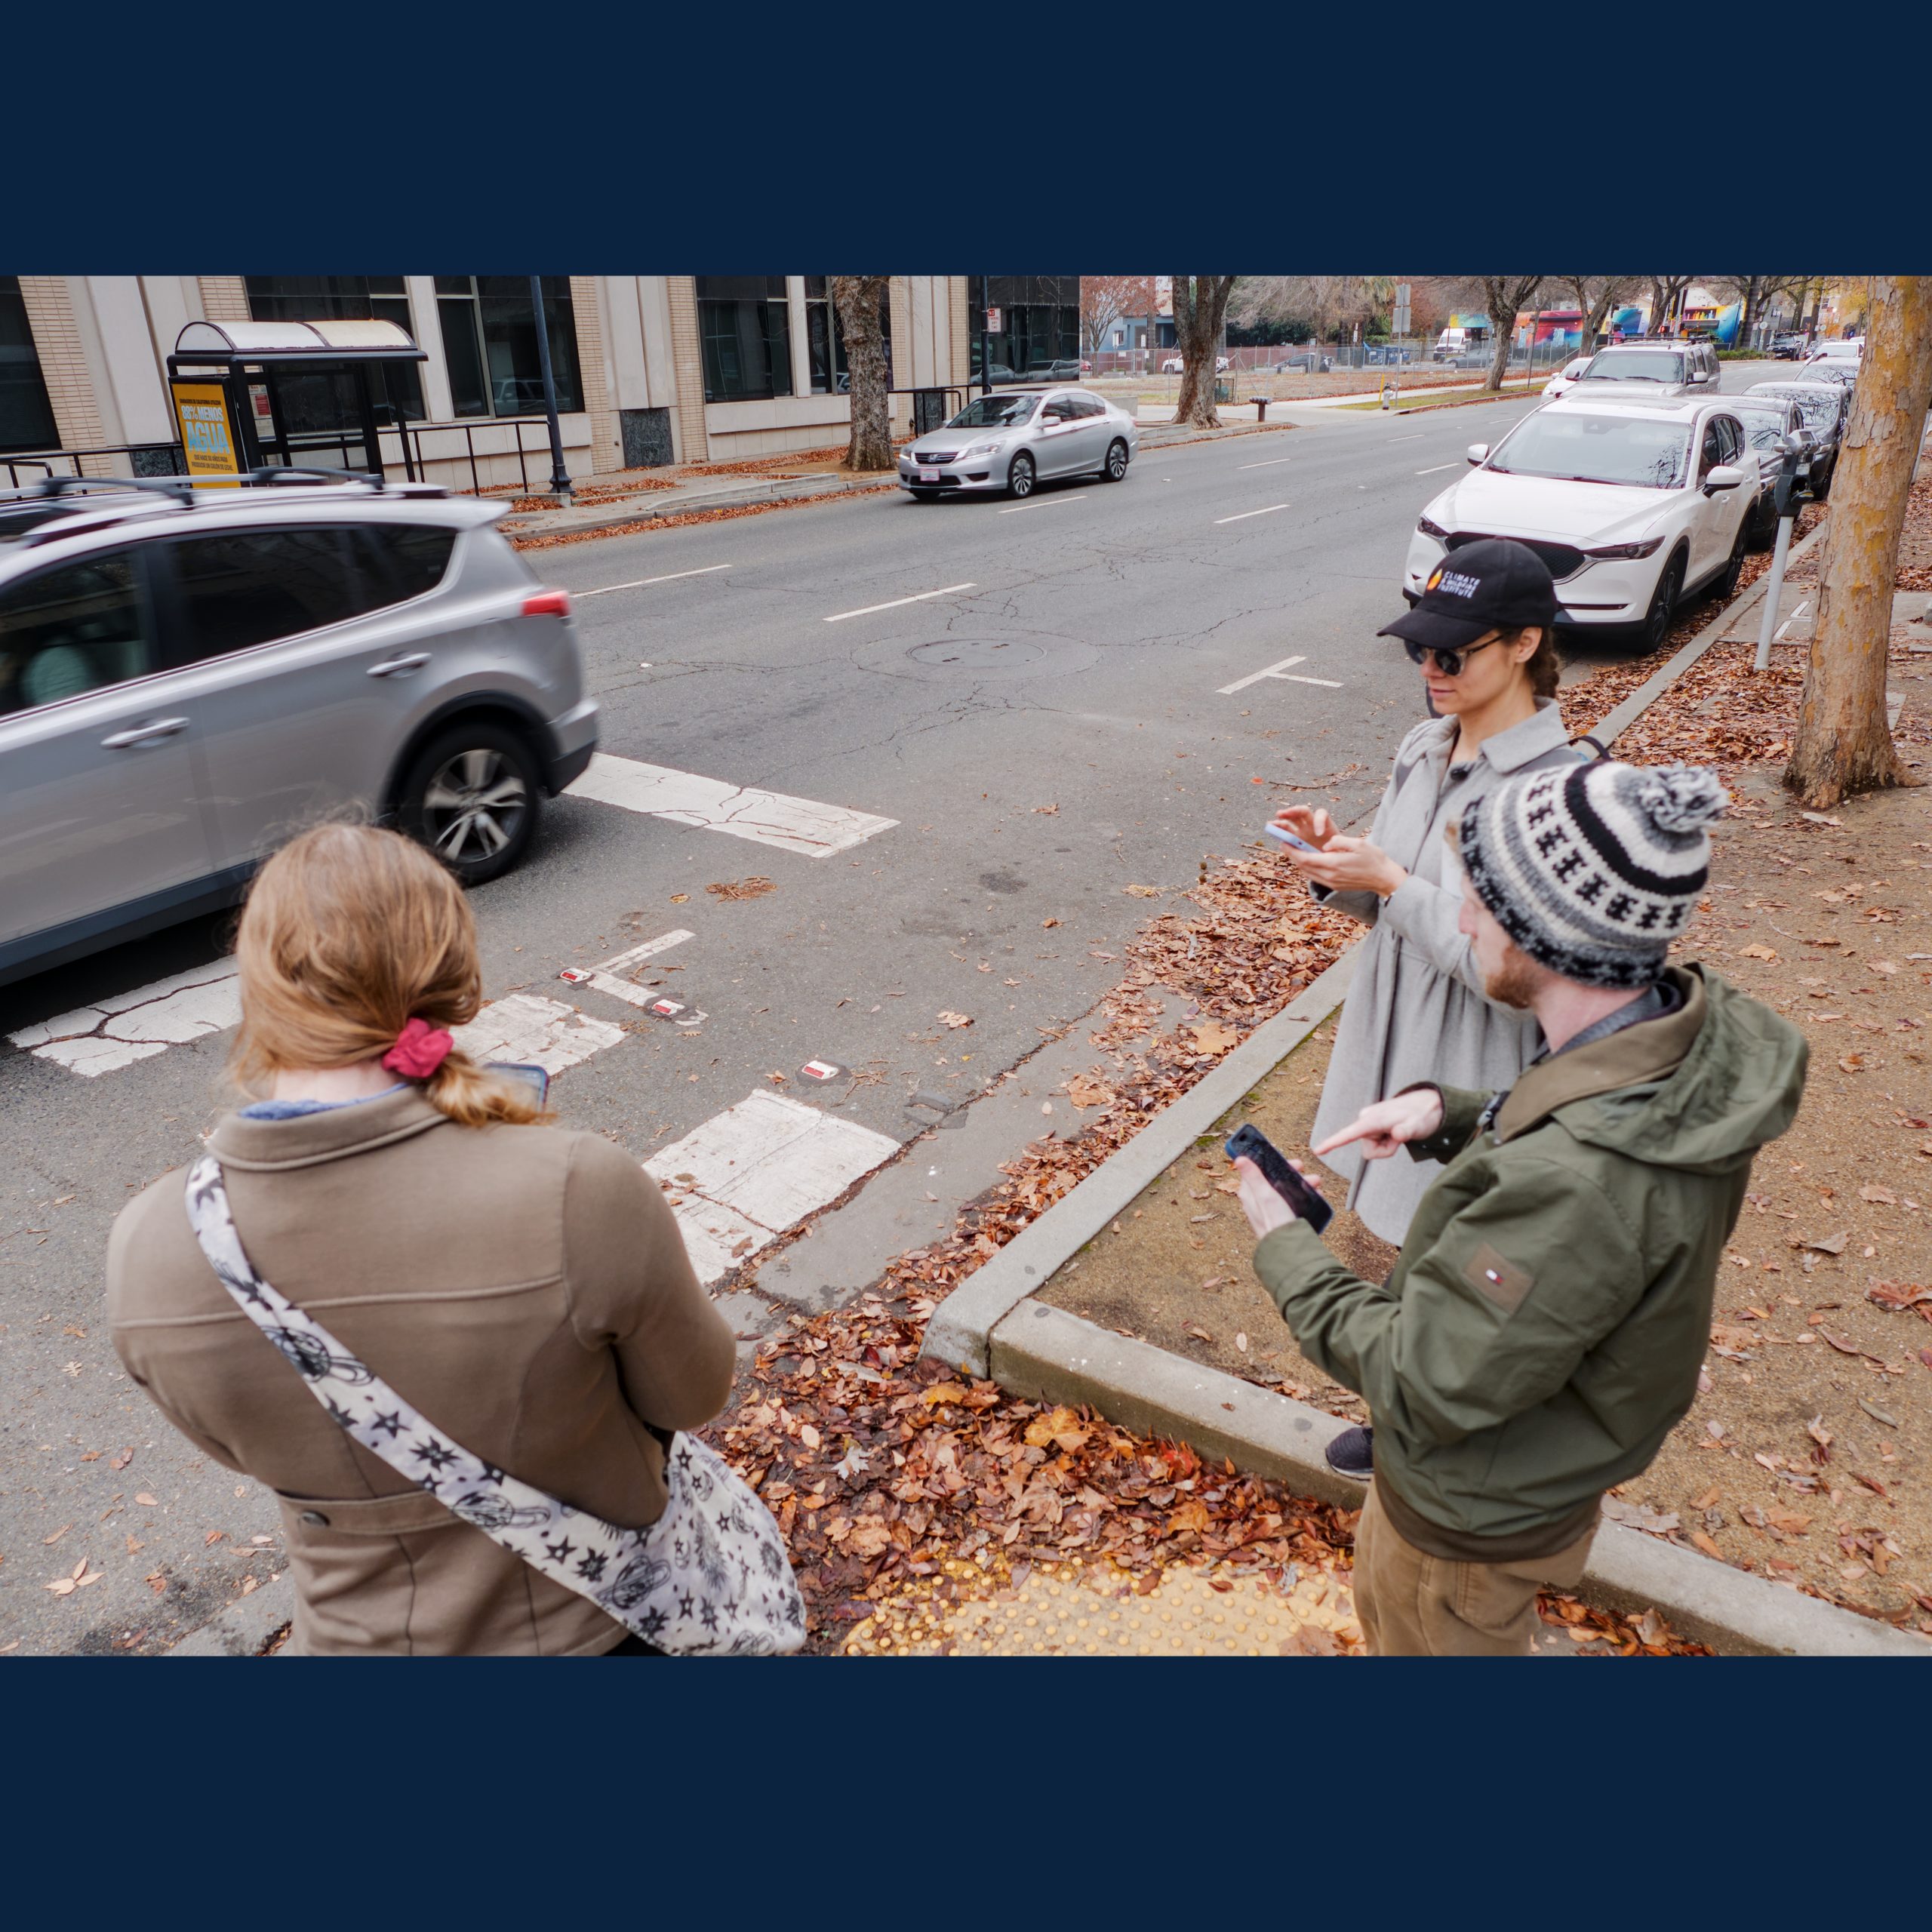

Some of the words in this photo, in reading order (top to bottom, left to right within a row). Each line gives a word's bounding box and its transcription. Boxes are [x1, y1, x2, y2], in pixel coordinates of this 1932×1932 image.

[181, 405, 198, 420] 88%
[197, 406, 223, 422] MENOS
[186, 421, 230, 454] AGUA
[1444, 571, 1481, 586] CLIMATE
[1446, 579, 1477, 592] WILDFIRE
[1437, 582, 1475, 598] INSTITUTE
